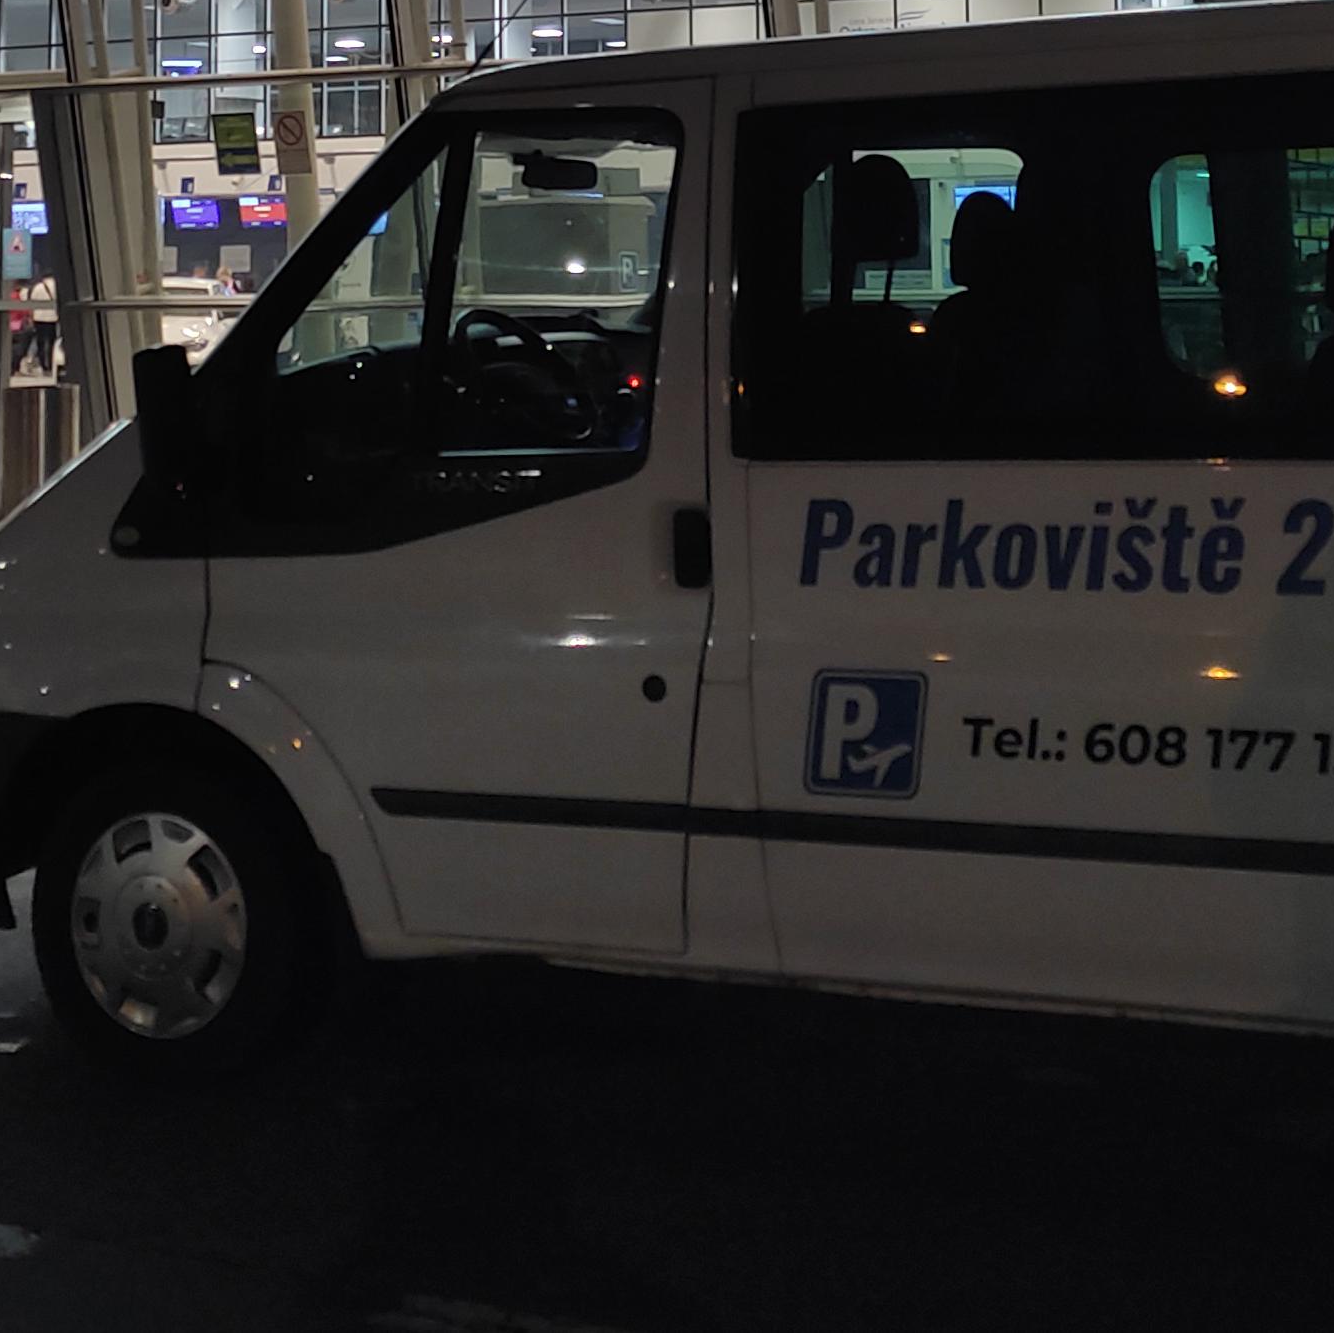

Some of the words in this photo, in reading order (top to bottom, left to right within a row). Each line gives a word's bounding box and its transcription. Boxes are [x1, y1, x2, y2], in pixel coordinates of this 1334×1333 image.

[799, 496, 1247, 594] Parkoviště
[963, 716, 1066, 762] Tel.:
[1083, 722, 1188, 768] 608
[1206, 726, 1295, 774] 177
